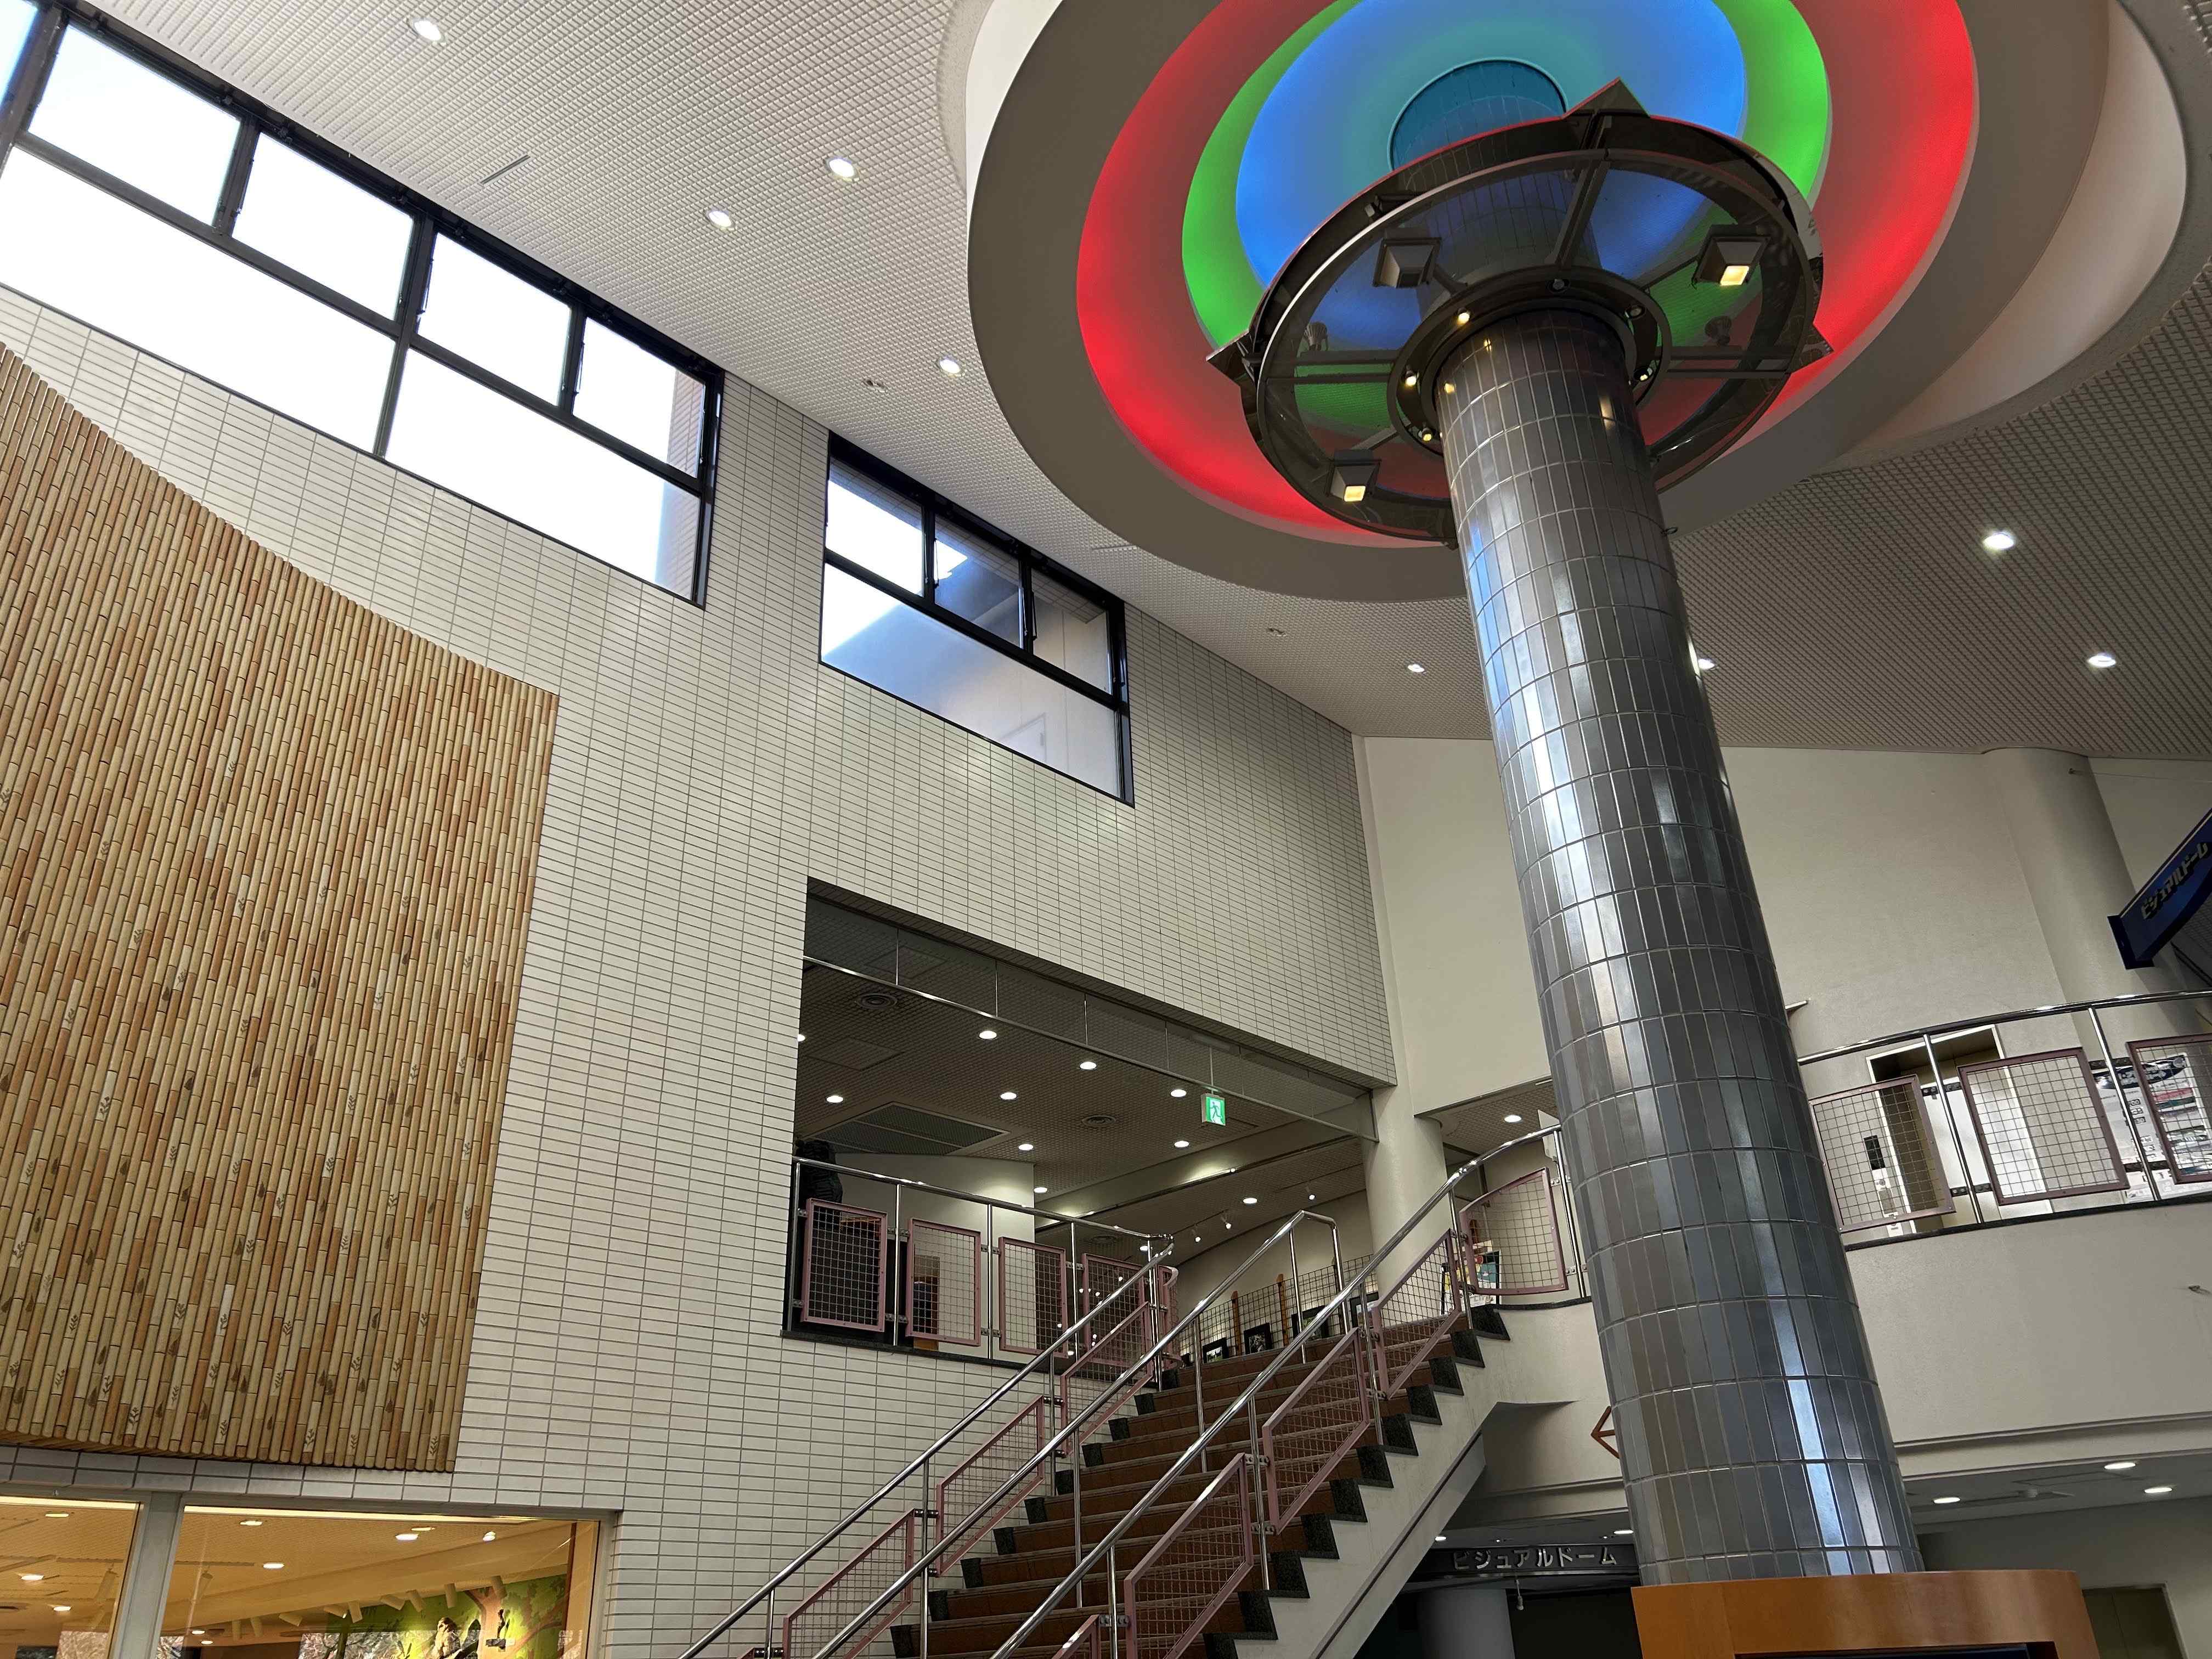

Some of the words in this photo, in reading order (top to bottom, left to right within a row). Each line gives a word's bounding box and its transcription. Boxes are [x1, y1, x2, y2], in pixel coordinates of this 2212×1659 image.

[2141, 843, 2208, 919] ビジュアルドーム
[1454, 1547, 1617, 1570] ビジュアルドーム
